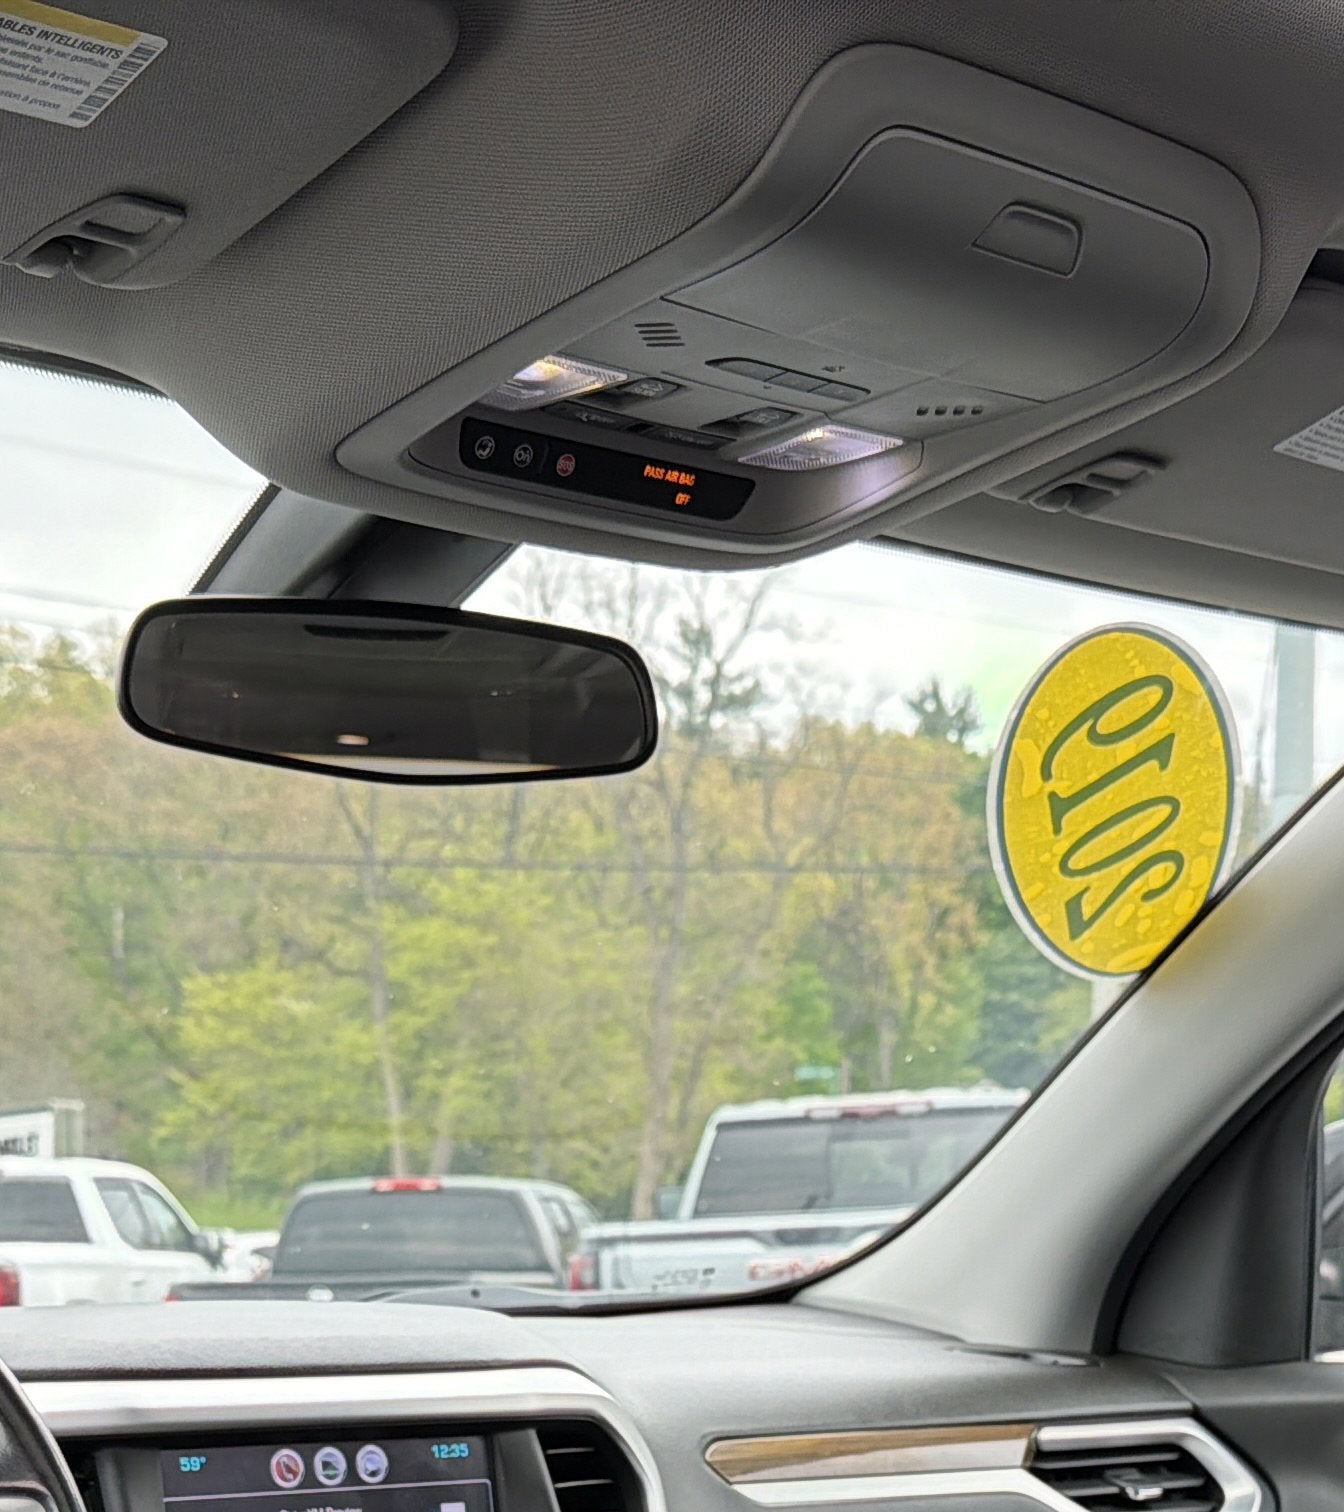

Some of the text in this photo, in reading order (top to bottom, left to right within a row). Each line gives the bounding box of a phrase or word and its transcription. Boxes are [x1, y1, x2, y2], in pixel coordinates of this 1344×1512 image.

[35, 29, 124, 59] INTELLIGENTS
[643, 464, 696, 487] PASS AIR BAG
[675, 492, 692, 506] OFF
[431, 1443, 469, 1459] 12:35
